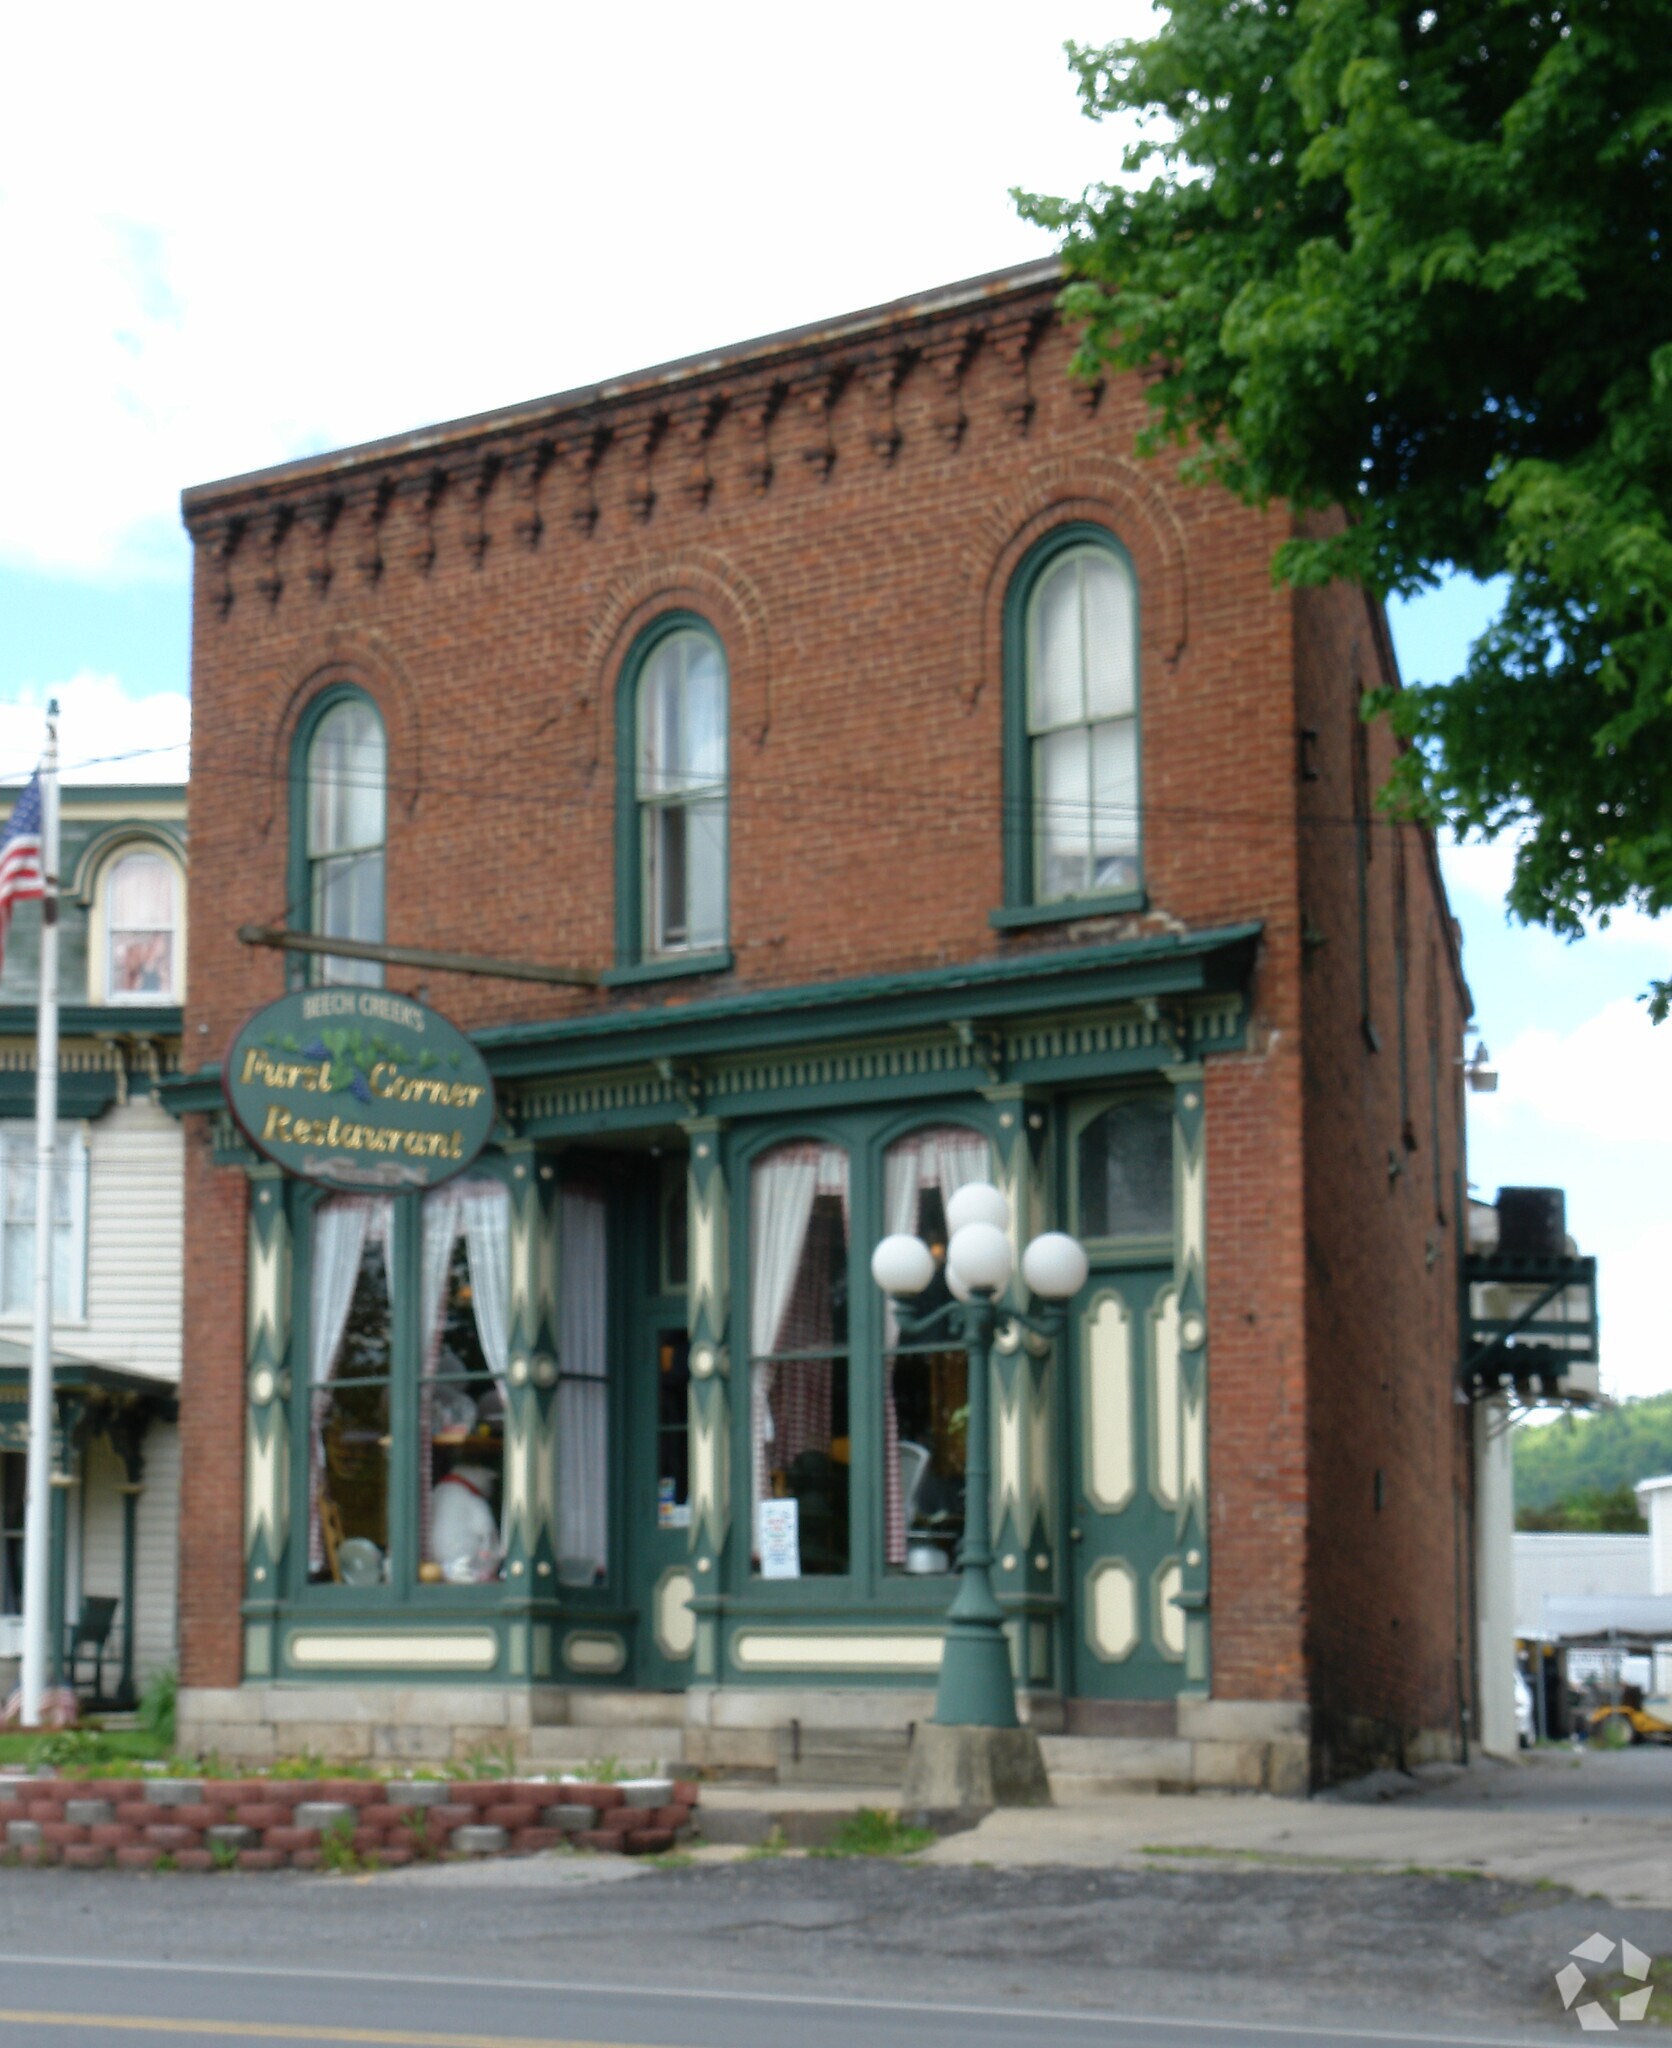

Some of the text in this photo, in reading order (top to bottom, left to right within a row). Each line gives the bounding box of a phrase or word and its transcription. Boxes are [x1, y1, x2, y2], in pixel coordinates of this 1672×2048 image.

[303, 991, 355, 1020] BEECH
[368, 1061, 485, 1107] Corner
[261, 1103, 463, 1159] Restaurant
